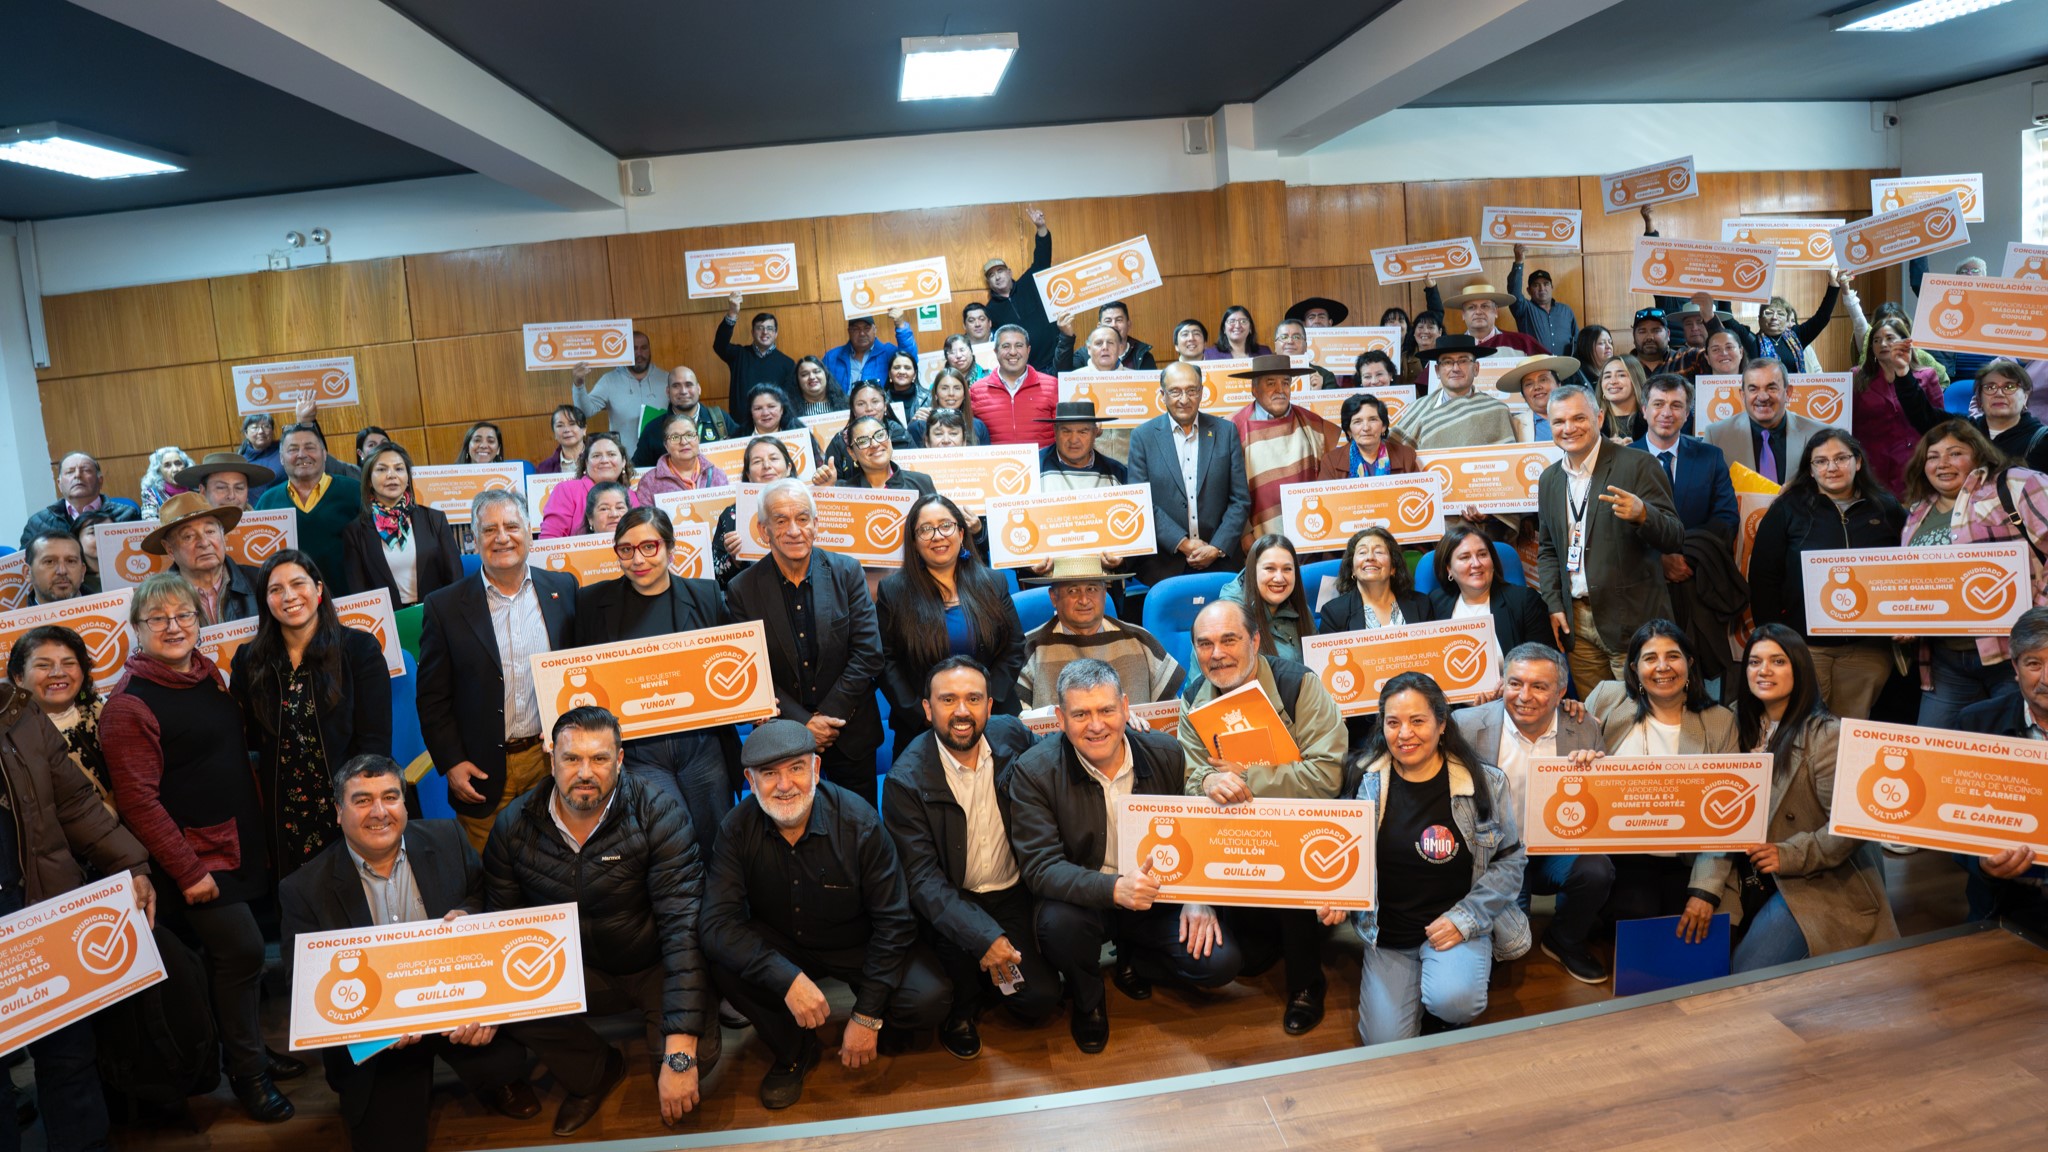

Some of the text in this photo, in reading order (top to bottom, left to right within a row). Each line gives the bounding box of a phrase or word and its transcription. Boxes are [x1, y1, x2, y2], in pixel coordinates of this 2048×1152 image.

[1929, 279, 2032, 290] CONCURSO VINCULACIÓN
[1935, 326, 1962, 336] CULTURA
[1994, 327, 2032, 336] QUIRIHUE
[1325, 481, 1368, 491] VINCULACIÓN
[1394, 477, 1433, 485] COMUNIDAD
[662, 496, 695, 504] CONCURSO
[992, 488, 1143, 508] CONCURSO COMUNIDAD
[240, 515, 288, 524] COMUNIDAD
[865, 508, 897, 520] ADJUDICADO
[104, 526, 150, 536] CONCURSO
[530, 543, 571, 553] CONCURSO
[1810, 556, 1856, 564] CONCURSO
[1859, 551, 1918, 562] VINCULACIÓN
[1957, 550, 2016, 558] COMUNIDAD
[1959, 566, 2002, 581] ADJUDICADO
[18, 598, 124, 626] CON LA COMUNIDAD
[1829, 609, 1860, 619] CULTURA
[1311, 638, 1353, 649] CONCURSO
[1355, 629, 1408, 643] VINCULACIÓN
[1410, 629, 1426, 637] CON
[1439, 622, 1486, 633] COMUNIDAD
[199, 644, 218, 654] 2026
[541, 655, 592, 669] CONCURSO
[595, 642, 659, 660] VINCULACIÓN
[662, 641, 681, 650] CON
[697, 630, 754, 644] COMUNIDAD
[1442, 639, 1475, 654] ADJUDICADO
[702, 651, 742, 669] ADJUDICADO
[1386, 659, 1429, 669] PORTEZUELO
[1387, 654, 1416, 662] TURISMO
[566, 667, 587, 675] 2026
[625, 670, 680, 684] CLUB ECUESTRE
[640, 677, 668, 689] NEWÉN
[1331, 689, 1358, 700] CULTURA
[640, 698, 676, 710] YUNGAY
[1853, 729, 2040, 758] CONCURSO VINCULACIÓN CON
[1883, 746, 1908, 755] 2026
[1595, 761, 1661, 771] VINCULACIÓN
[1953, 768, 2030, 785] UNIÓN COMUNAL
[1701, 779, 1744, 795] ADJUDICADO
[1941, 776, 2042, 795] DE JUNTAS DE VECINOS
[1983, 790, 2025, 801] CARMEN
[1128, 805, 1182, 813] CONCURSO
[1187, 803, 1255, 814] VINCULACIÓN
[1259, 807, 1280, 815] CON
[1298, 808, 1362, 816] COMUNIDAD
[1653, 799, 1685, 807] CORTÉZ
[1867, 803, 1911, 820] CULTURA
[1625, 819, 1668, 827] QUIRIHUE
[1952, 810, 2022, 827] EL CARMEN
[1217, 828, 1271, 837] ASOCIACIÓN
[1299, 828, 1345, 844] ADJUDICADO
[1552, 825, 1588, 836] CULTURA
[1209, 837, 1279, 847] MULTICULTURAL
[1424, 838, 1452, 854] AMUQ
[1224, 846, 1264, 855] QUILLÓN
[1147, 870, 1183, 882] CULTURA
[1223, 866, 1265, 876] QUILLÓN
[18, 882, 124, 930] CON LA COMUNIDAD
[71, 912, 116, 943] ADJUDICADO
[307, 913, 565, 949] CONCURSO VINCULACIÓN CON LA COMUNIDAD
[10, 935, 44, 954] HUASOS
[501, 934, 549, 954] ADJUDICADO
[338, 949, 361, 958] 2026
[30, 955, 44, 966] DE
[396, 951, 483, 970] GRUPO FOLCLÓRICO
[441, 964, 452, 972] DE
[454, 957, 493, 970] QUILLÓN
[28, 962, 50, 978] ALTO
[417, 985, 464, 1001] QUILLÓN
[1, 986, 49, 1015] QUILLÓN
[326, 1004, 370, 1021] CULTURA
